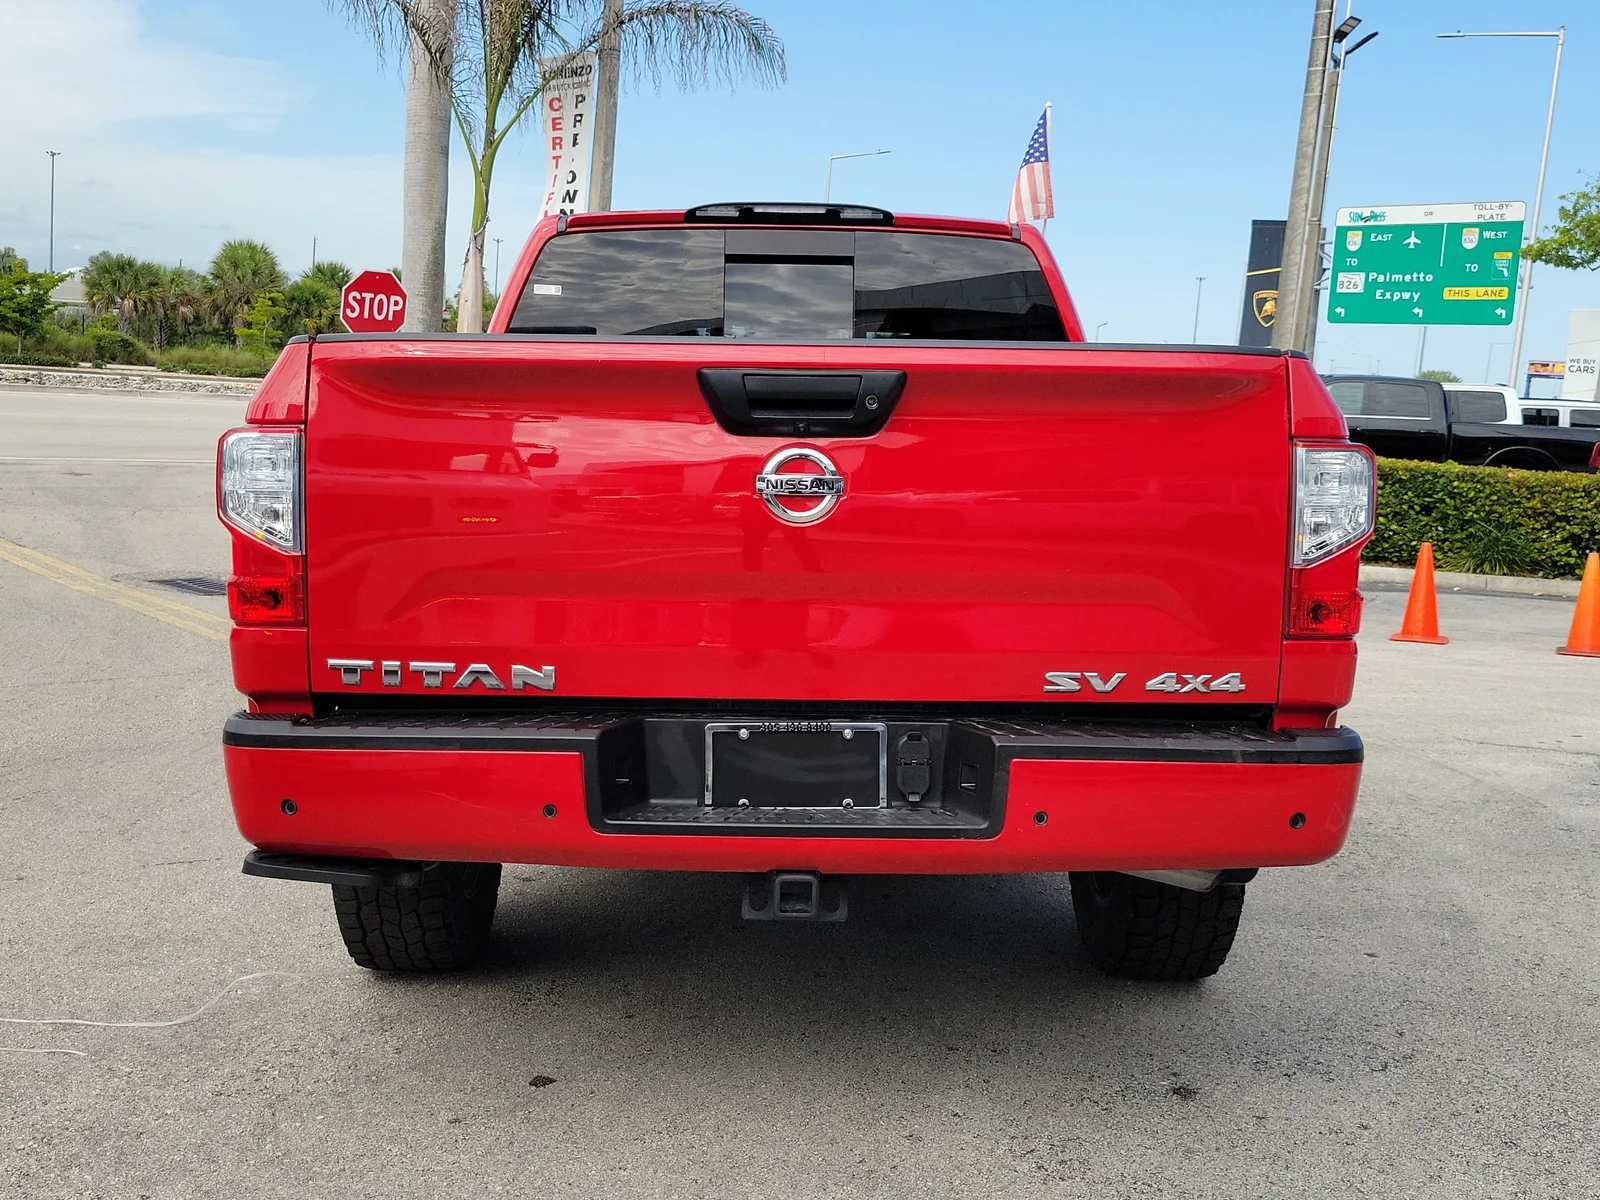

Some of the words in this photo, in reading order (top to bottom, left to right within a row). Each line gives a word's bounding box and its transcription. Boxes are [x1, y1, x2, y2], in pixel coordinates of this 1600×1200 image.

[1477, 213, 1506, 221] PLATE
[1370, 233, 1393, 242] EAST
[1482, 230, 1508, 239] WEST
[1345, 258, 1358, 266] TO
[1465, 263, 1479, 272] TO
[1368, 272, 1434, 283] Palmetto
[1338, 280, 1359, 290] 826
[1375, 289, 1421, 303] Expwy
[1447, 289, 1470, 298] THIS
[1475, 289, 1505, 298] LANE
[346, 291, 404, 321] STOP
[1568, 365, 1596, 374] CARS
[766, 479, 835, 491] NISSAN
[327, 659, 556, 691] TITAN
[1043, 672, 1128, 693] SV
[1145, 672, 1246, 693] 4x4
